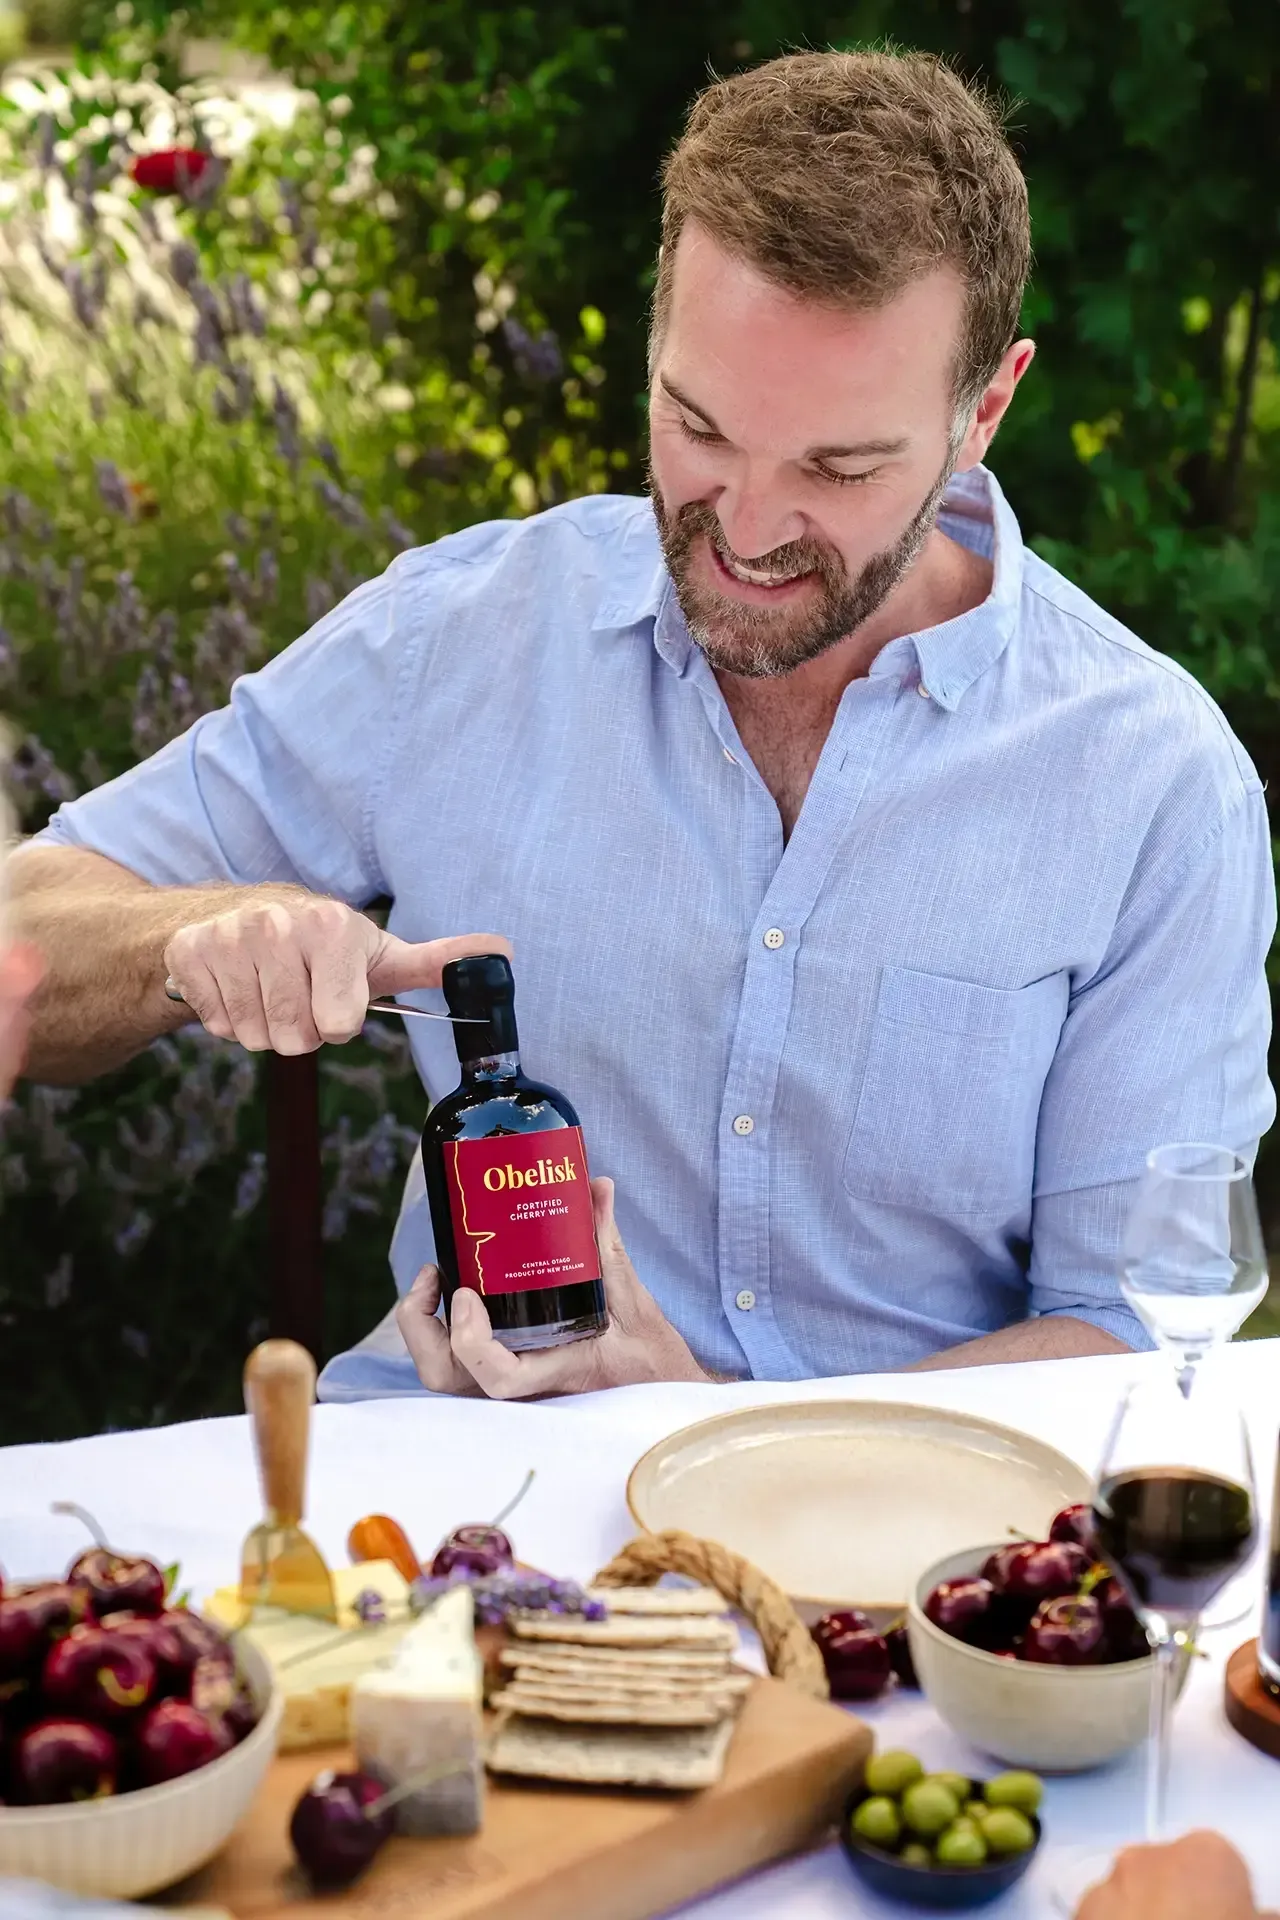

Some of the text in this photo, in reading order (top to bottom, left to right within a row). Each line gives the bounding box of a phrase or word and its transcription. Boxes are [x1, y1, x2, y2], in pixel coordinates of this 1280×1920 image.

[483, 1156, 578, 1191] Obelisk
[516, 1199, 562, 1211] FORTIFIED
[510, 1206, 569, 1221] CHERRY WINE
[522, 1256, 571, 1269] CENTRAL OTAGO
[504, 1269, 535, 1279] PRODUCT
[547, 1266, 561, 1274] NEW
[562, 1262, 585, 1272] ZEALAND
